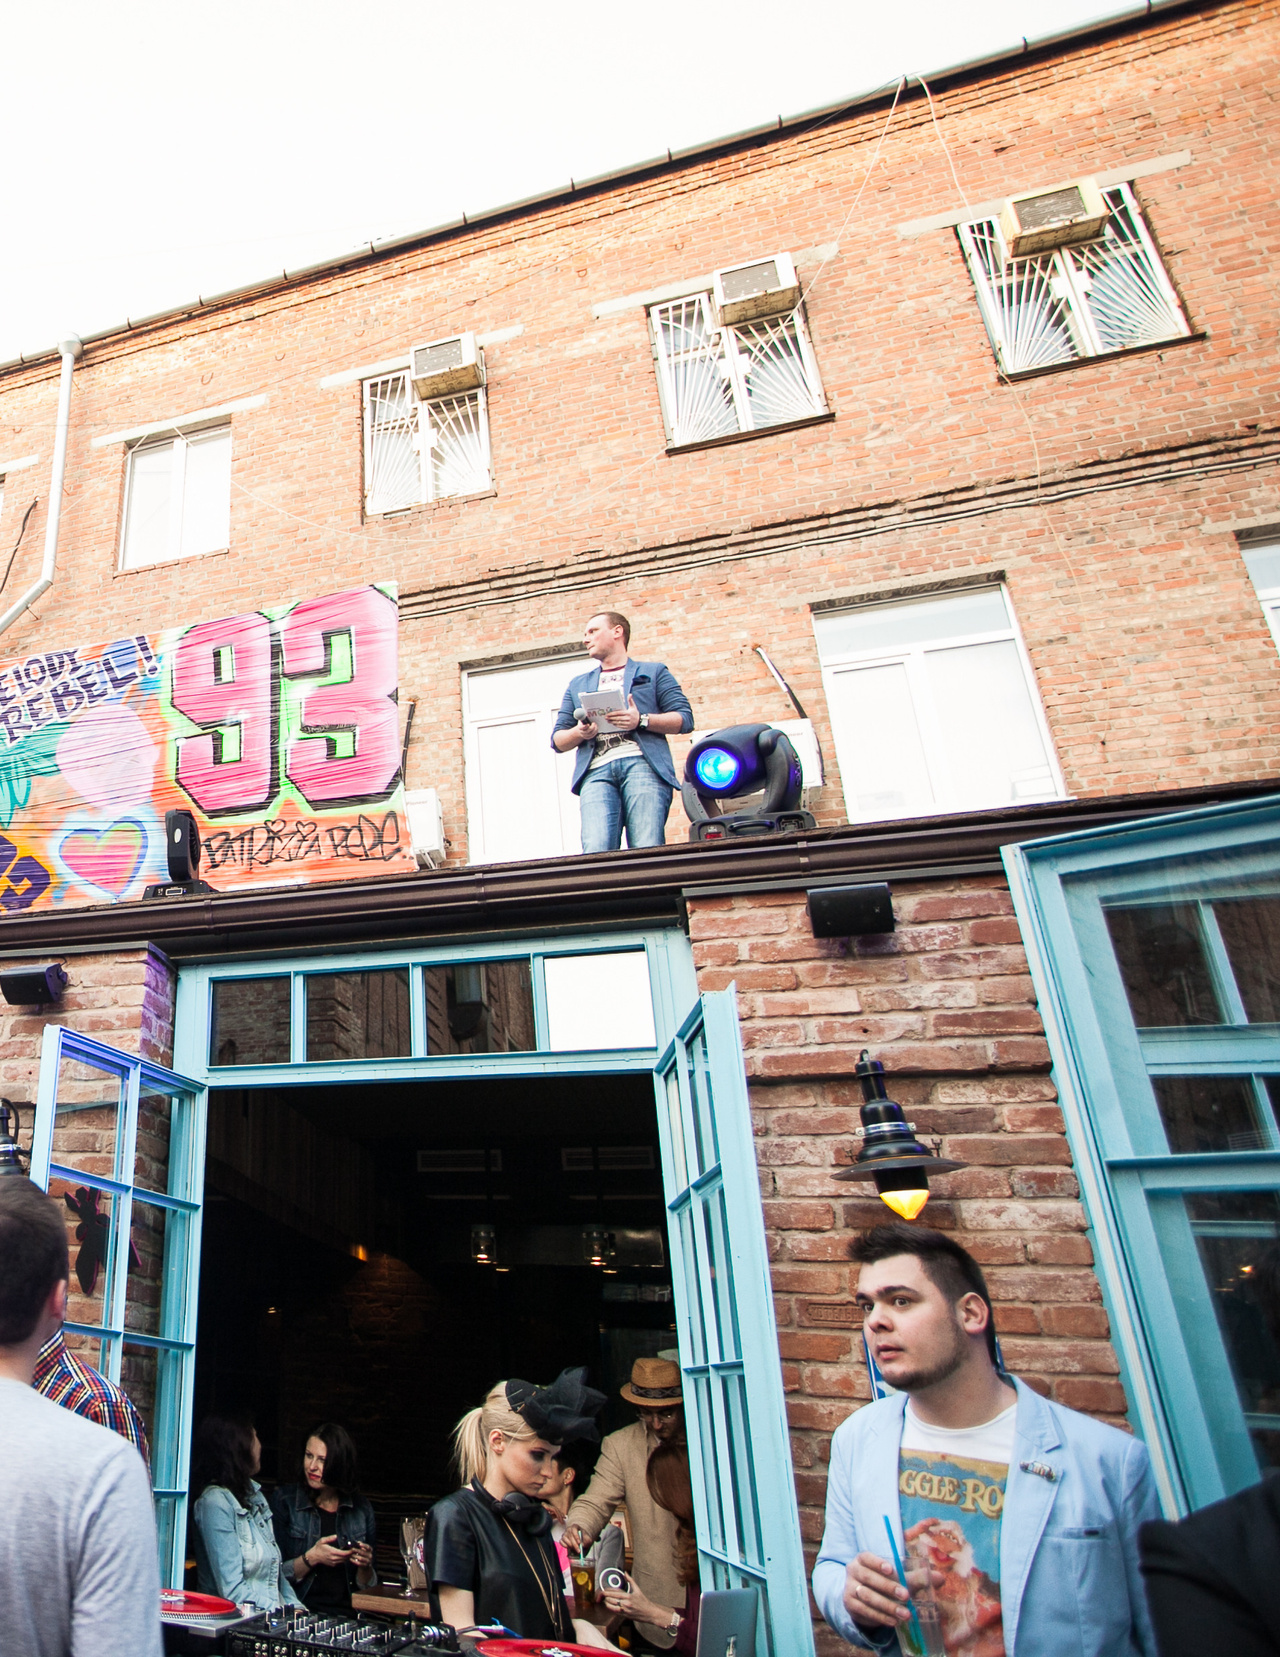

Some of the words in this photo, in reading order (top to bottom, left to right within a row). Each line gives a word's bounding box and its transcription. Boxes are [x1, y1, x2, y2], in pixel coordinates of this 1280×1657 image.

[171, 584, 402, 820] 93
[899, 1468, 960, 1506] GGLE
[960, 1478, 1005, 1521] RO
